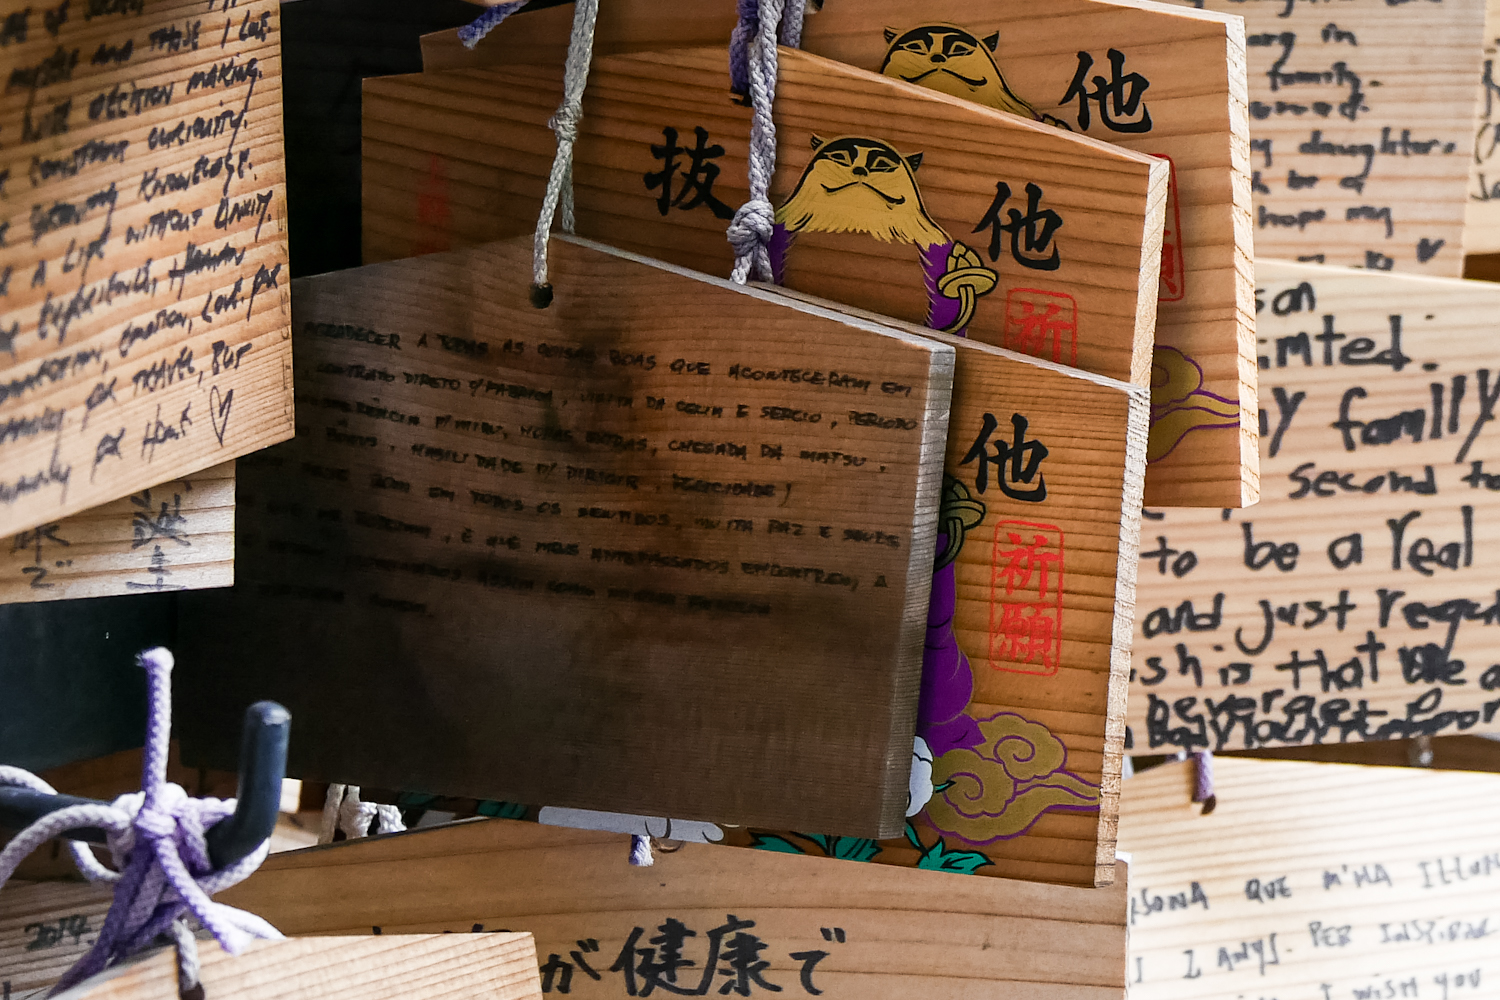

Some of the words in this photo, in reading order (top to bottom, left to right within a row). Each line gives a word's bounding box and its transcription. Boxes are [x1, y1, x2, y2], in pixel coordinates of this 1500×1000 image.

[1059, 48, 1152, 134] 他
[643, 125, 733, 221] 抜
[972, 181, 1064, 271] 他
[960, 412, 1049, 502] 他
[1287, 461, 1437, 500] second
[1139, 535, 1198, 578] to
[1241, 520, 1301, 572] be
[1327, 532, 1365, 571] a
[1386, 504, 1475, 577] real
[998, 532, 1062, 671] 祈願
[1141, 591, 1227, 639] and
[1234, 588, 1357, 656] just
[1130, 642, 1204, 688] sh
[1274, 630, 1387, 693] that
[1244, 877, 1293, 904] QUE
[540, 914, 848, 997] が健康で
